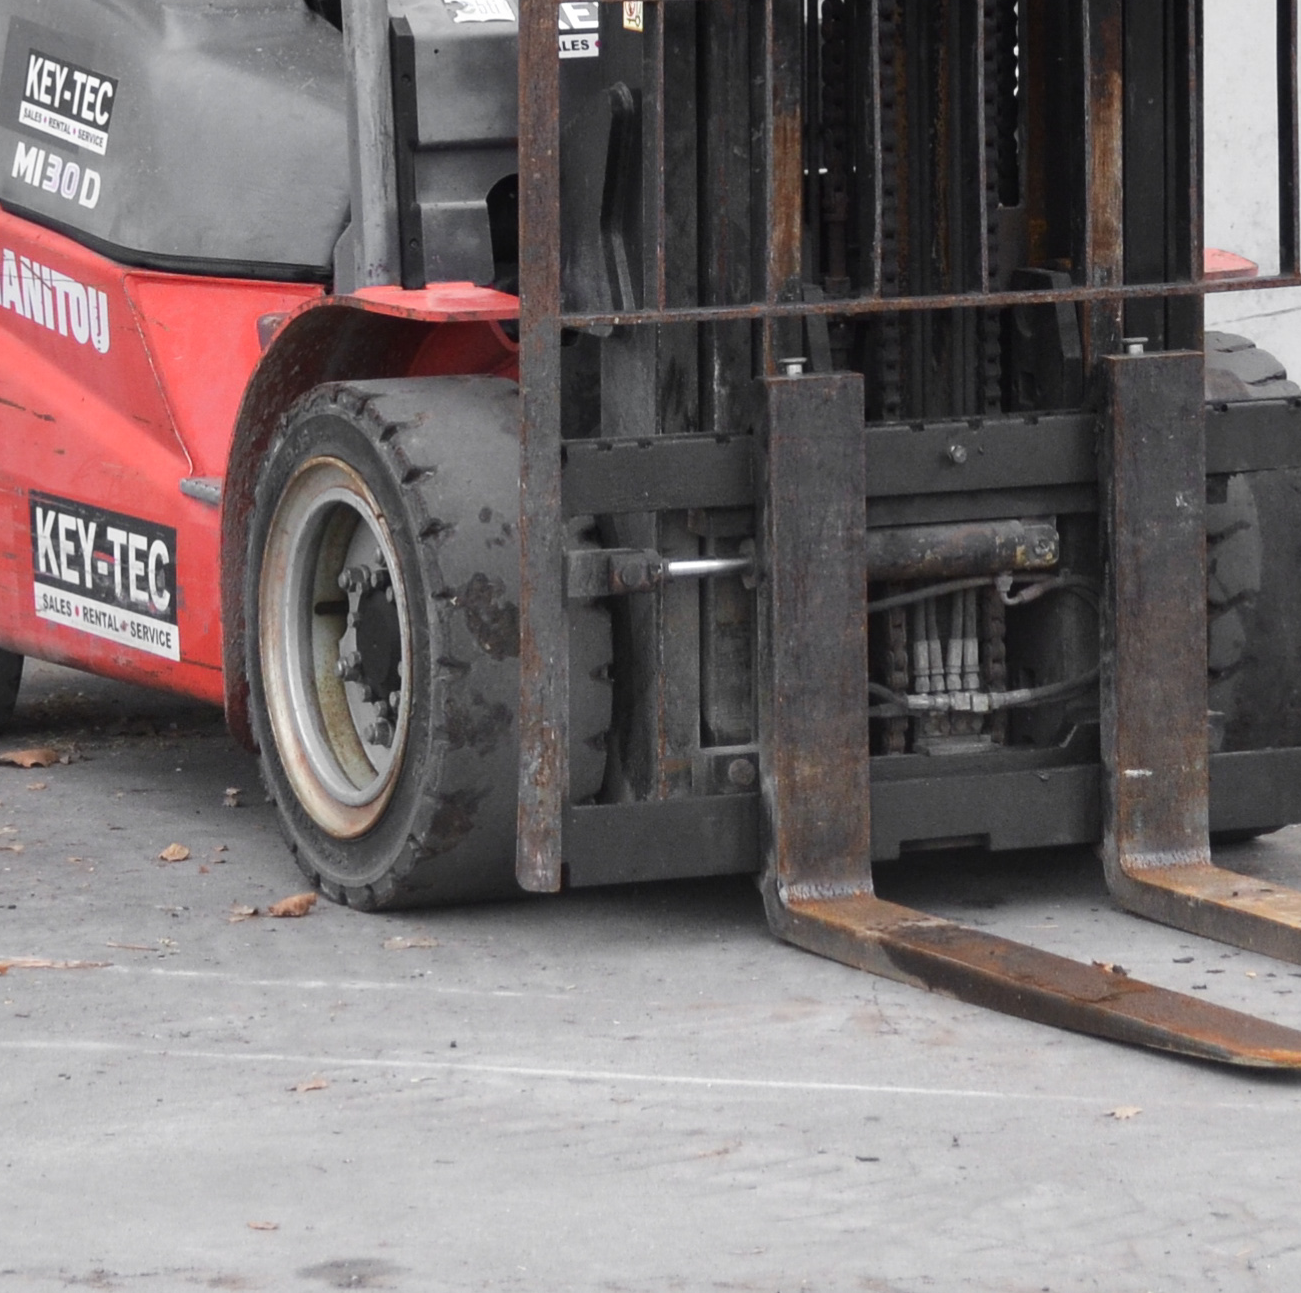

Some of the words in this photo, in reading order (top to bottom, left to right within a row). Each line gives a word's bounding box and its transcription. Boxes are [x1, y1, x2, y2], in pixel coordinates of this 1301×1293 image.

[559, 39, 590, 52] LES
[25, 54, 113, 126] KEY-TEC
[23, 108, 43, 124] SALES
[48, 117, 71, 135] RENTAL
[77, 128, 105, 148] SERVICE
[36, 506, 171, 612] KEY-TEC
[42, 593, 72, 617] SALES
[82, 605, 119, 633] RENTAL
[130, 620, 172, 649] SERVICE
